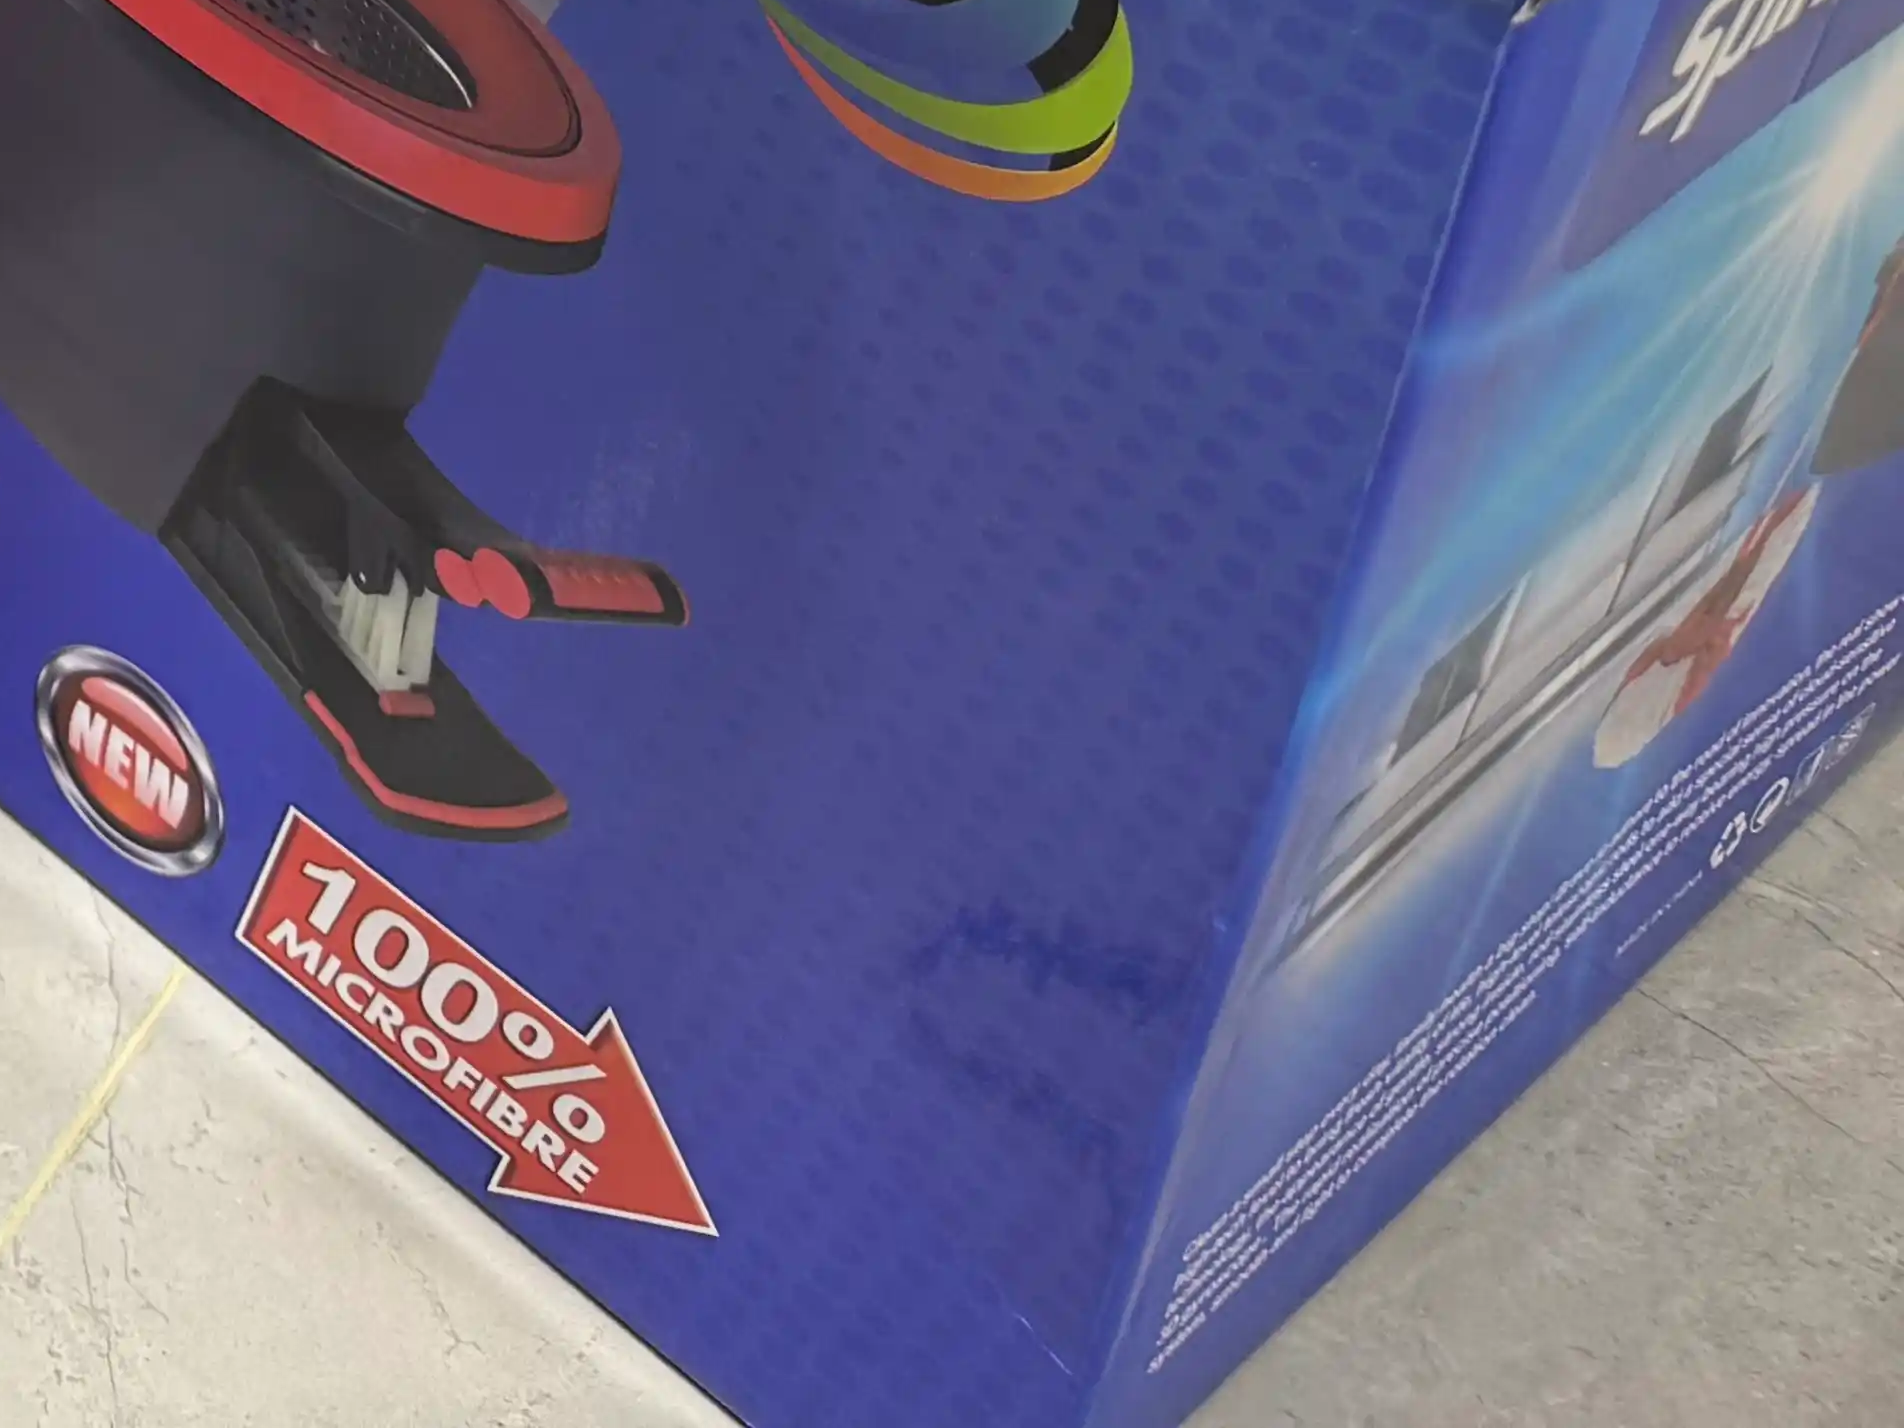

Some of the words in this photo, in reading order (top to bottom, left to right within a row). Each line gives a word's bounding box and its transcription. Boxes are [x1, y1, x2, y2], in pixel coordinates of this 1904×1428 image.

[68, 698, 190, 830] NEW
[265, 917, 600, 1194] MICROFIBRE
[302, 860, 607, 1143] 100%
